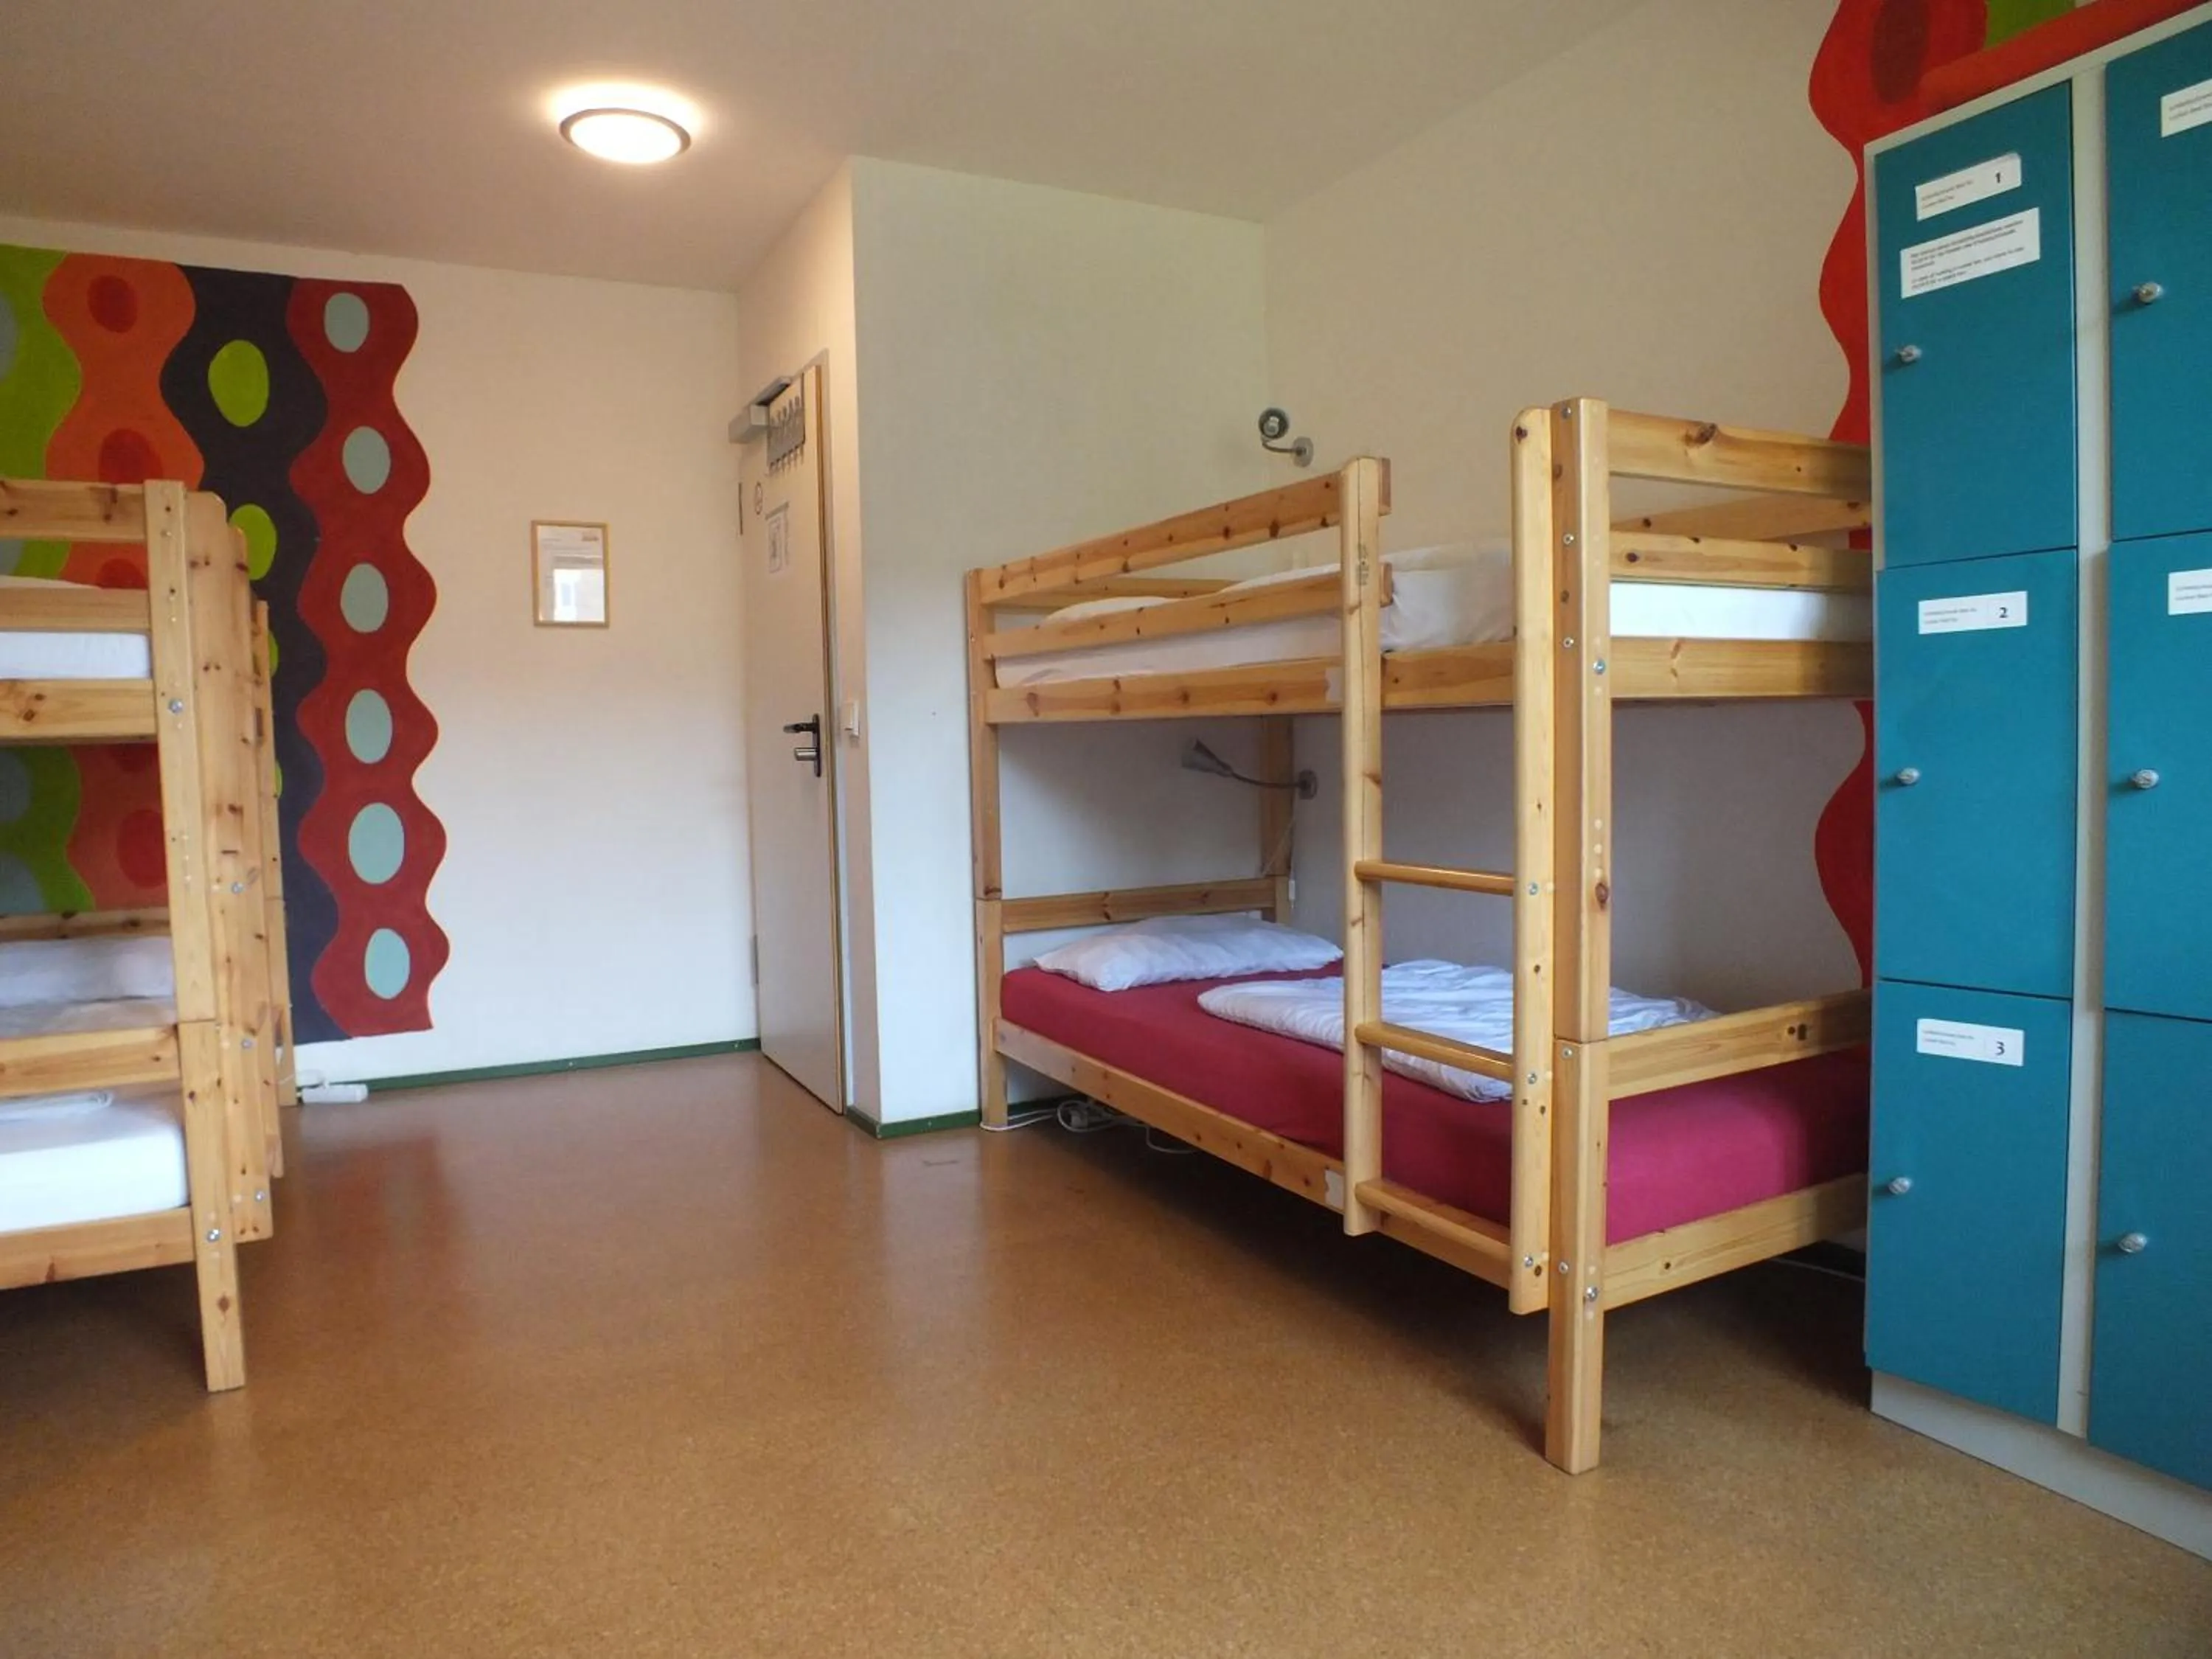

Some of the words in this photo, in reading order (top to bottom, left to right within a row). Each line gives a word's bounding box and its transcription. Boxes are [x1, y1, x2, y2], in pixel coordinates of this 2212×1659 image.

[1994, 172, 2001, 184] 1
[1999, 606, 2008, 619] 2
[1995, 1040, 2005, 1056] 3
